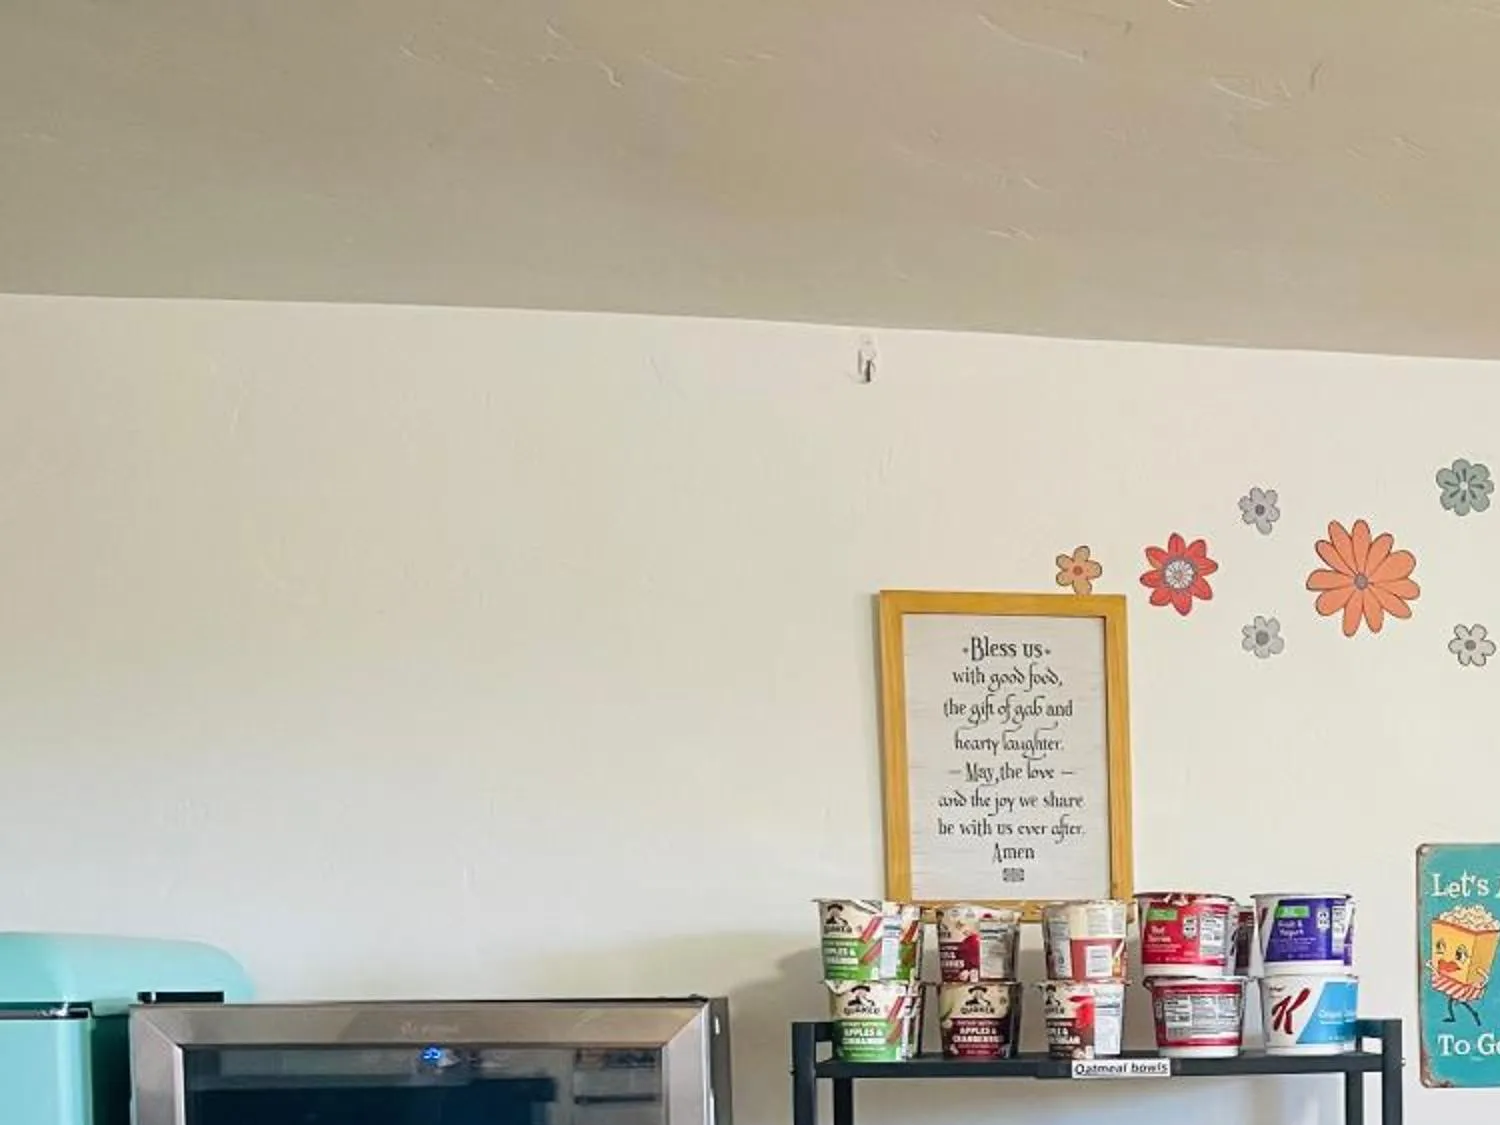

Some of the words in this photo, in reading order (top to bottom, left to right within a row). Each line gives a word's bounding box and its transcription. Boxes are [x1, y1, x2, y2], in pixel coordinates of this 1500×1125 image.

[971, 636, 1017, 661] Bless
[1022, 643, 1043, 658] us
[953, 666, 985, 685] with
[988, 666, 1025, 692] good
[1024, 662, 1063, 692] food,
[944, 697, 966, 717] the
[968, 694, 995, 724] gift
[998, 693, 1016, 724] of
[1012, 695, 1046, 724] gab
[1045, 699, 1073, 716] and
[954, 726, 999, 756] hearty
[1000, 761, 1022, 780] the
[1027, 760, 1055, 779] love
[938, 790, 967, 807] and
[971, 786, 990, 807] the
[988, 792, 1015, 816] joy
[1019, 796, 1038, 807] we
[1043, 790, 1084, 808] share
[938, 817, 955, 835] be
[959, 818, 992, 837] with
[997, 823, 1013, 835] us
[1017, 824, 1048, 835] ever
[992, 842, 1035, 863] Amen
[1431, 870, 1489, 898] Let's
[1438, 1034, 1470, 1057] To
[1075, 1063, 1128, 1075] Oatmeal
[1131, 1062, 1168, 1075] bowls
